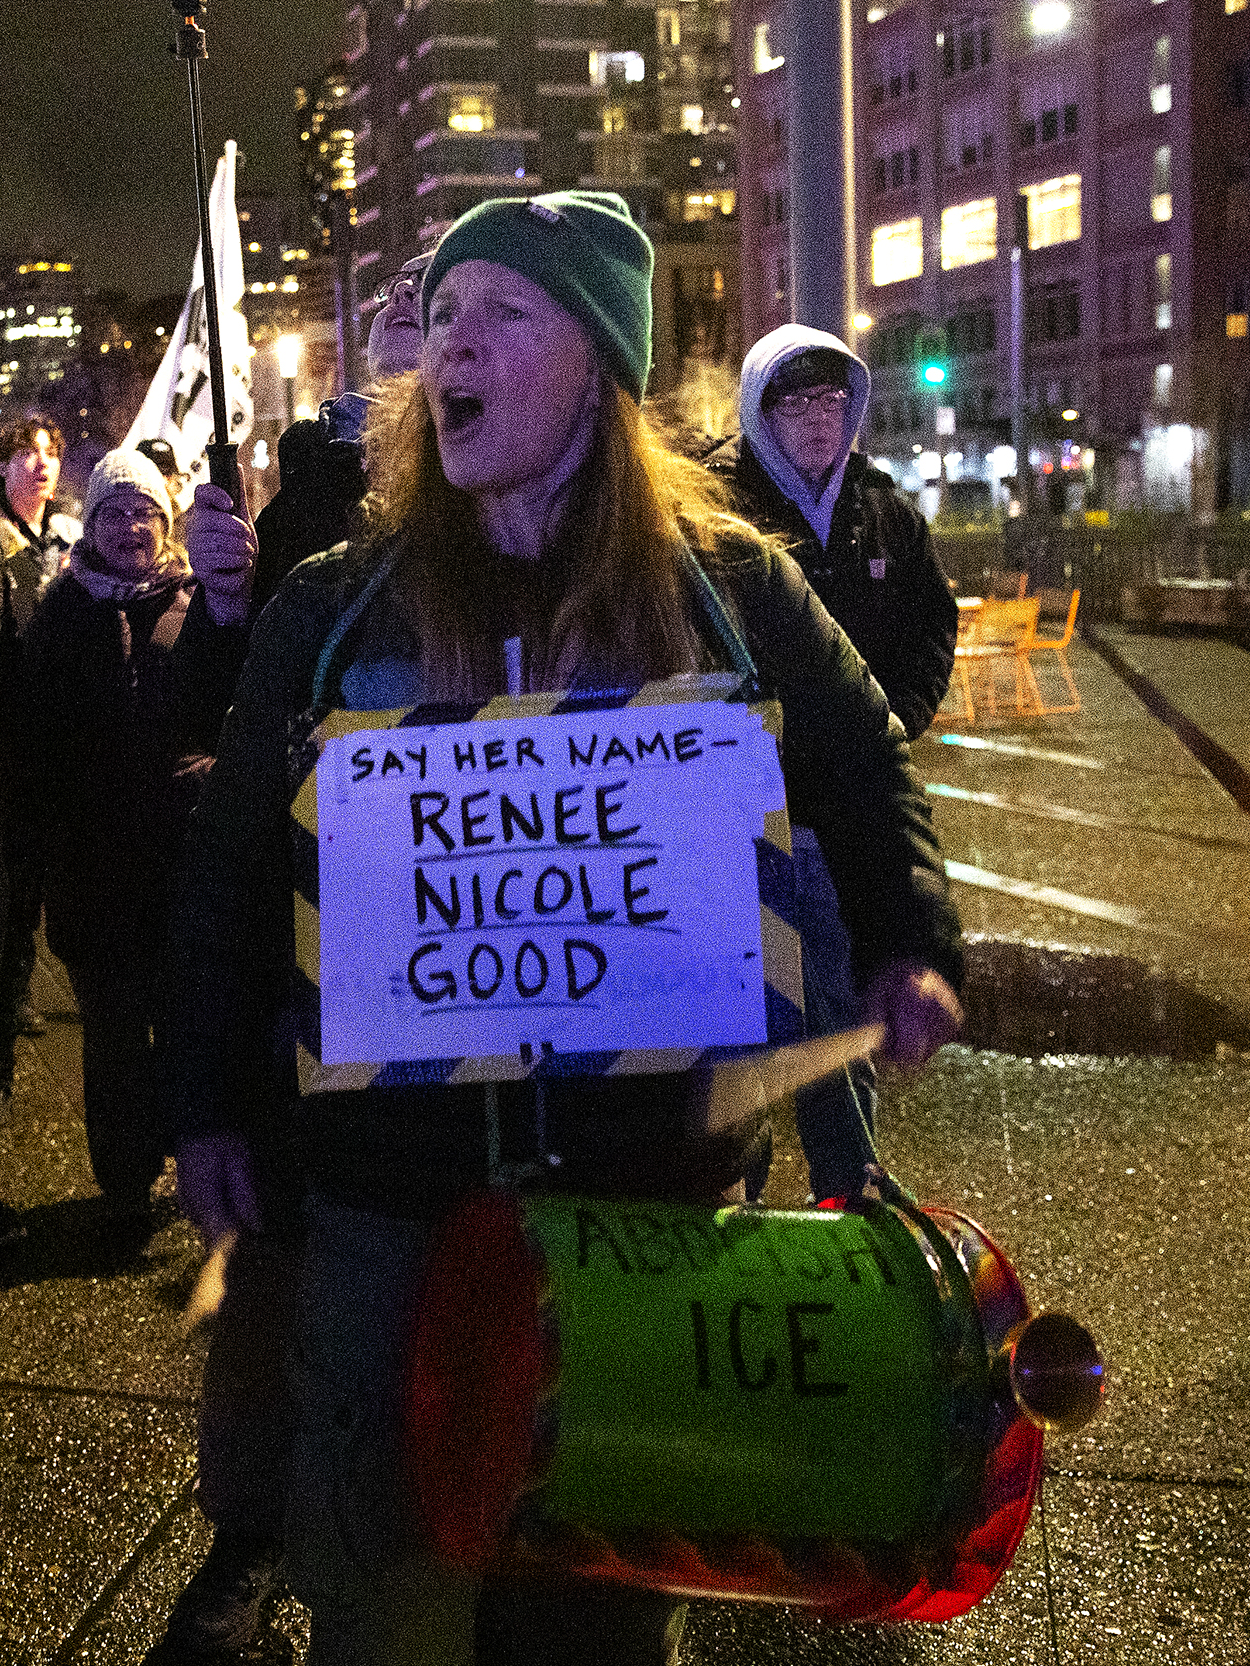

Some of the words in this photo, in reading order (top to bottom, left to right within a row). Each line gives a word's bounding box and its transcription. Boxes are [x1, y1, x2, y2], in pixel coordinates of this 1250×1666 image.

[351, 744, 428, 781] SAY
[453, 736, 545, 773] HER
[409, 780, 642, 851] RENEE
[414, 857, 669, 929] NICOLE
[407, 938, 608, 1003] GOOD
[573, 1206, 899, 1287] ABOLISH
[688, 1296, 850, 1398] ICE
